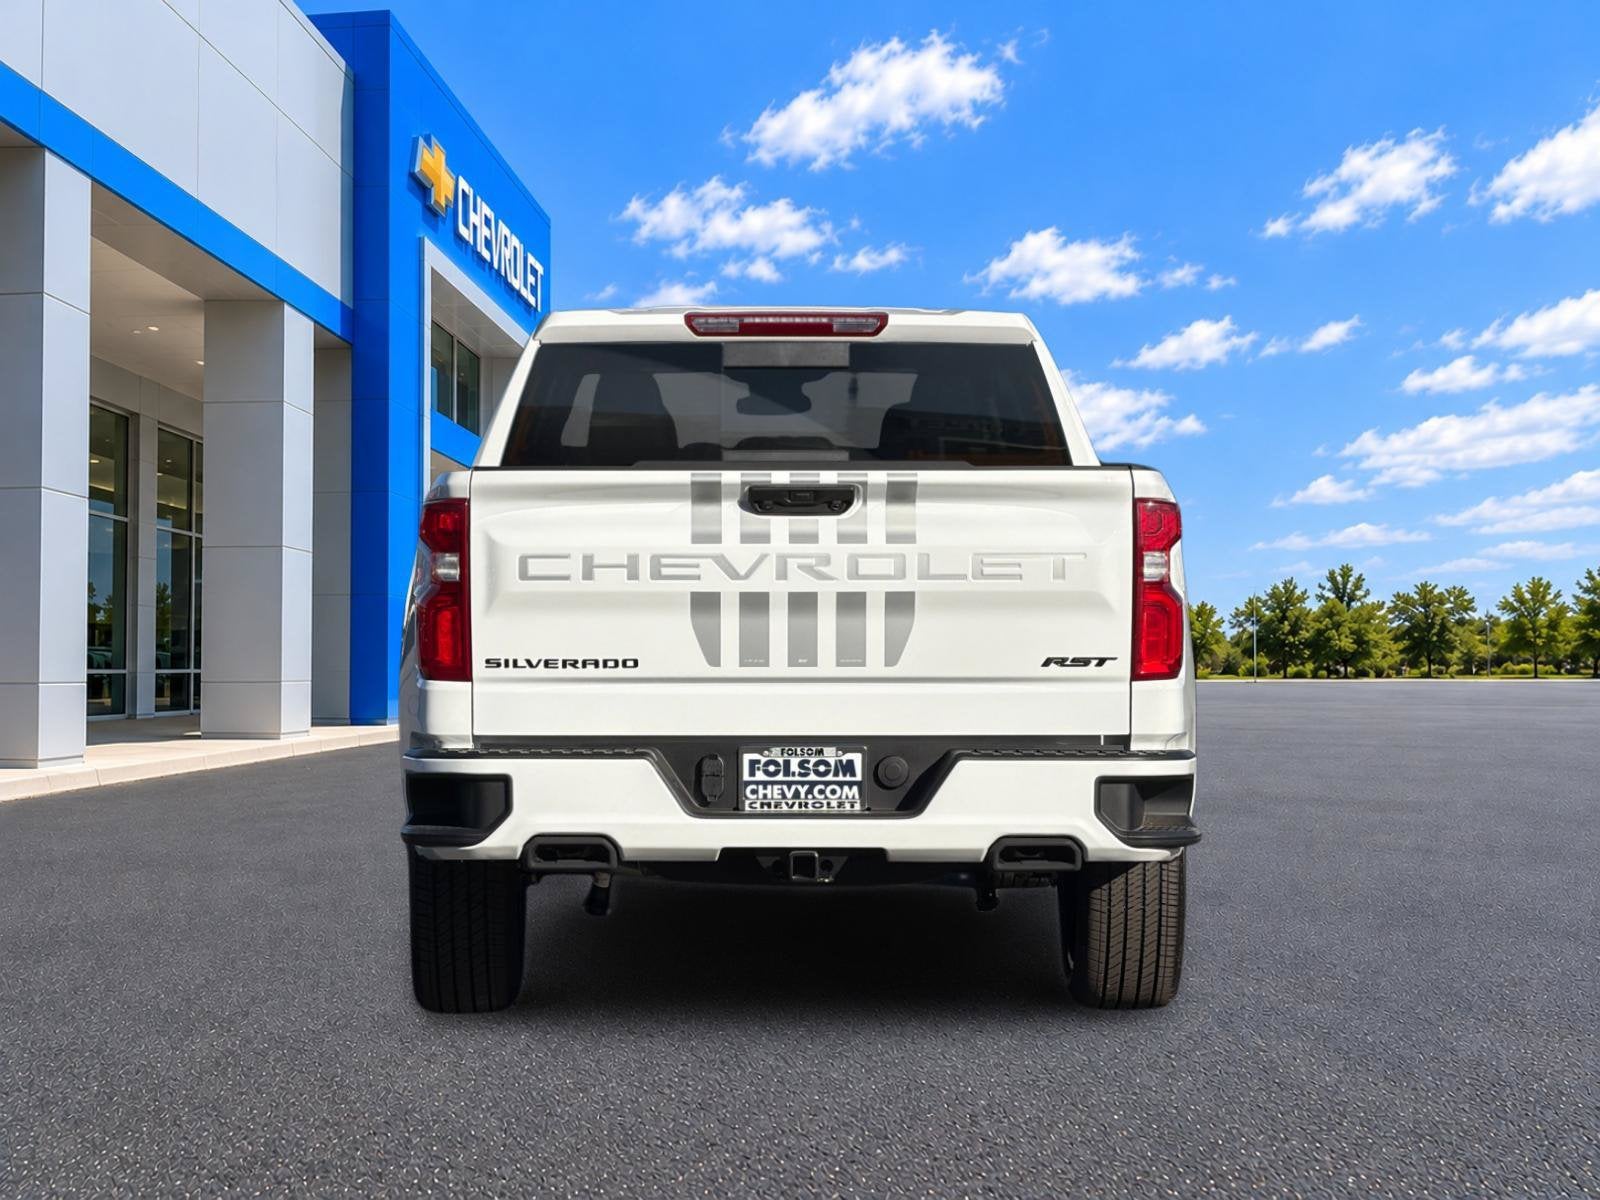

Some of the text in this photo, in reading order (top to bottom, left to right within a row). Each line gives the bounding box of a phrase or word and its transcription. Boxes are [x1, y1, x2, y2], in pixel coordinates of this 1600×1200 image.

[457, 175, 544, 312] CHEVROLET
[518, 553, 1087, 581] CHEVROLET
[484, 658, 640, 669] SILVERADO
[1041, 656, 1118, 668] RST
[780, 747, 825, 757] FOLSOM
[748, 759, 857, 778] FOLSOM
[745, 784, 860, 800] CHEVY.COM
[748, 801, 859, 810] CHEVROLET
